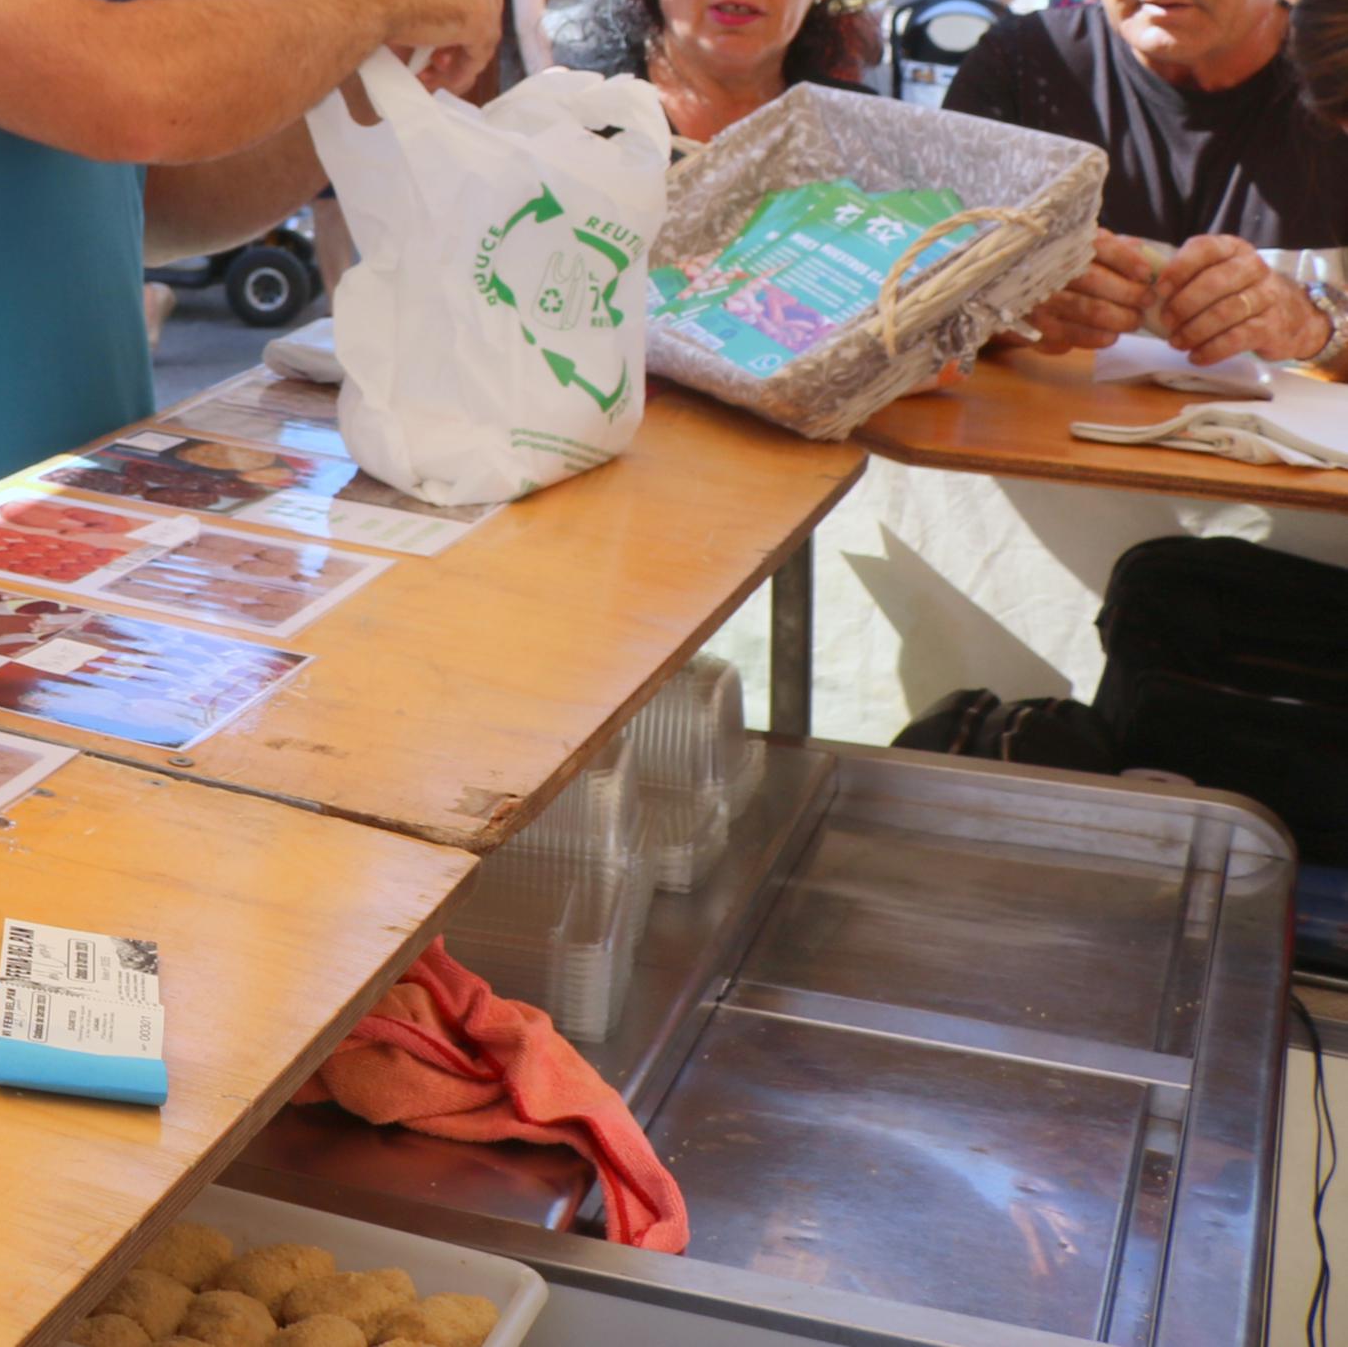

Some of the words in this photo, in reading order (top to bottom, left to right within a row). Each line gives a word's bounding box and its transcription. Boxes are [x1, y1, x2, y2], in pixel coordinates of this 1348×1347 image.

[9, 925, 34, 946] PAN
[5, 957, 32, 979] FERIA
[2, 1011, 14, 1029] FERIA
